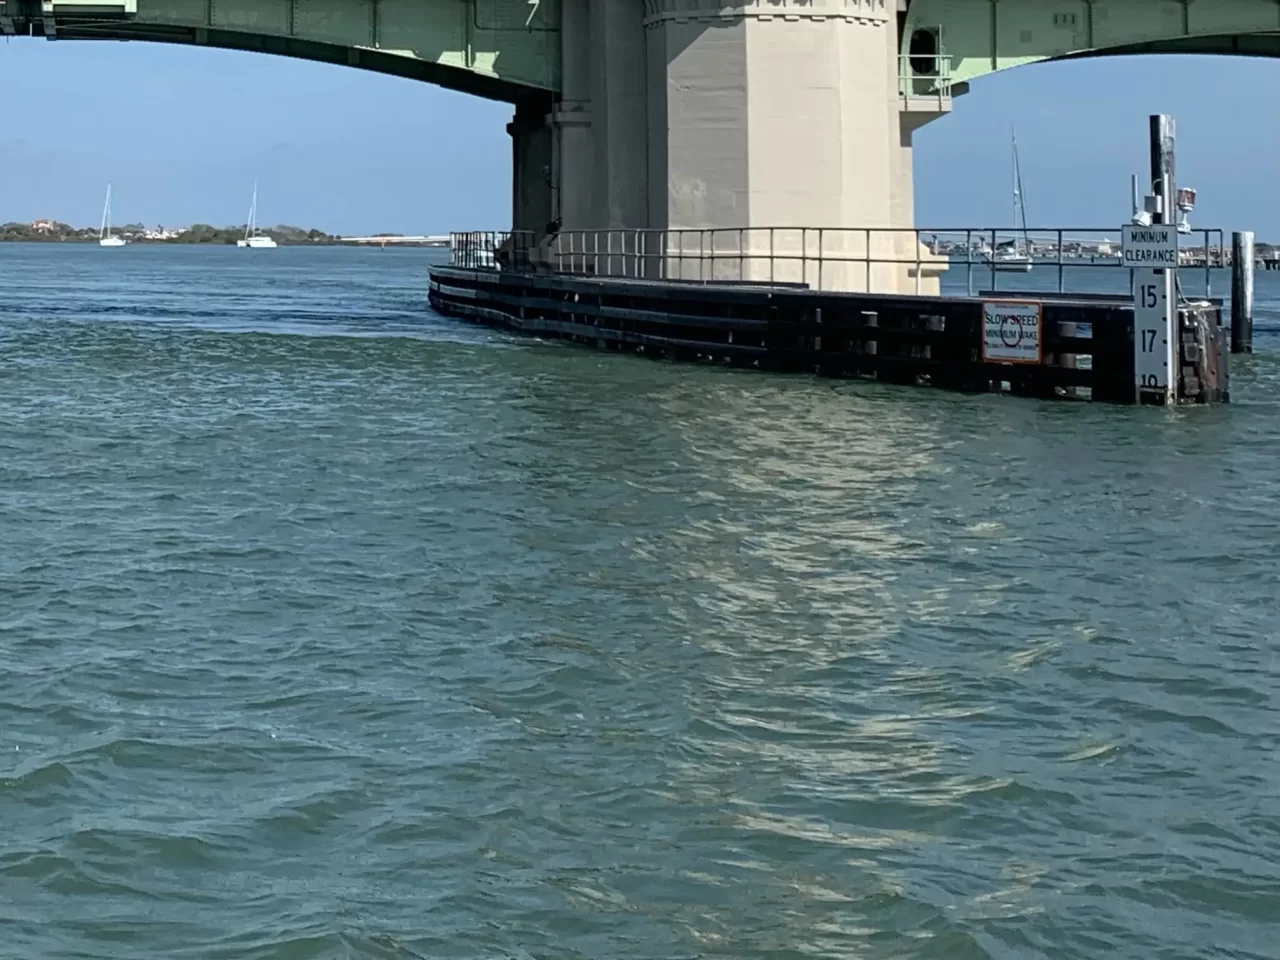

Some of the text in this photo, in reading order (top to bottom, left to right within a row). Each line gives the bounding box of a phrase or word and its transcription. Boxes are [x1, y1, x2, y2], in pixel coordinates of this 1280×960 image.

[1131, 231, 1168, 244] MINIMUM
[1125, 249, 1175, 262] CLEARANCE
[1140, 284, 1157, 309] 15
[985, 313, 1038, 326] SLOW SPEED
[986, 329, 1017, 339] MINIMUM
[1141, 329, 1157, 353] 17
